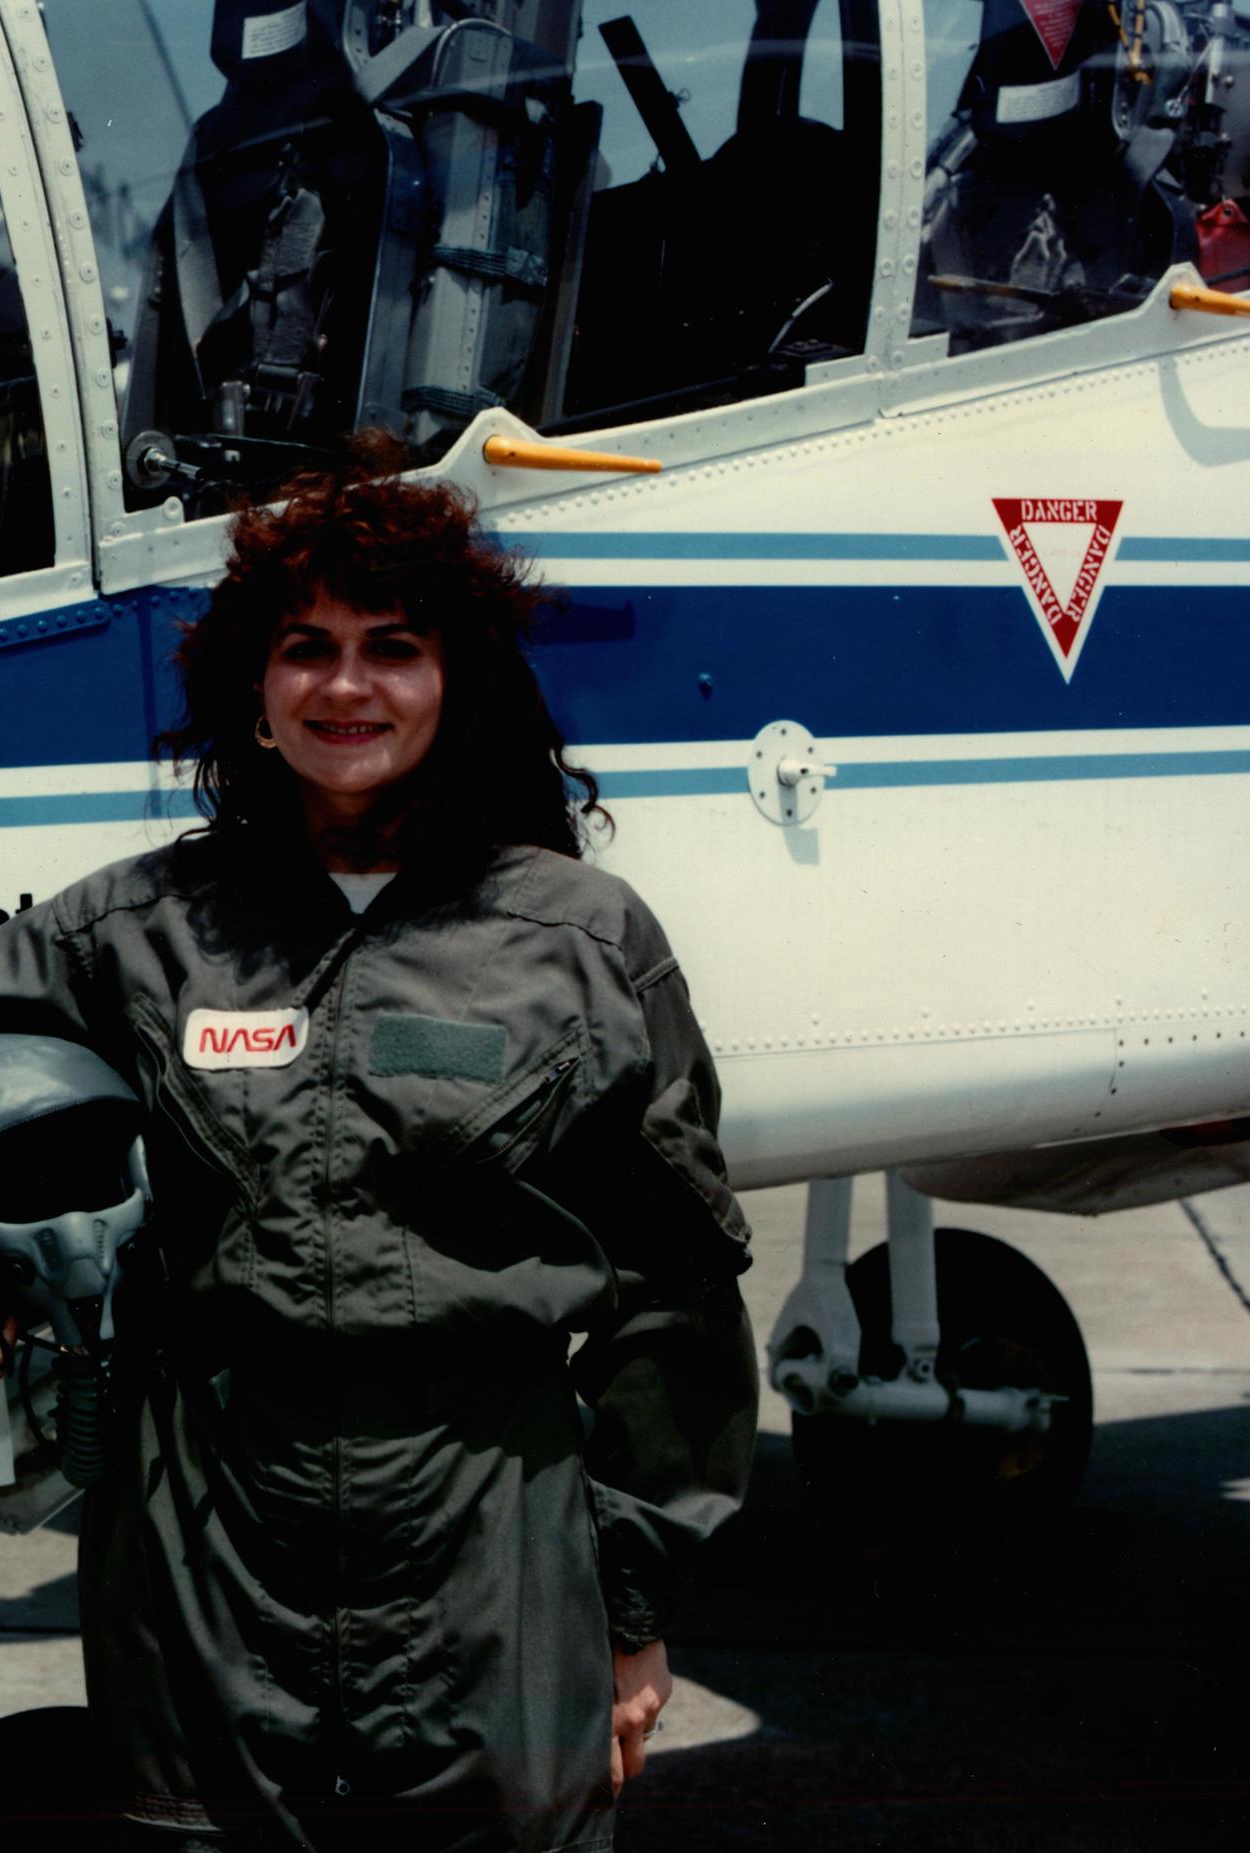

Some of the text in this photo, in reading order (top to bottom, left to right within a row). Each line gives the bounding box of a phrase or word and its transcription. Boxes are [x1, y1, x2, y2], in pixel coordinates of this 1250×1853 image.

[1021, 501, 1098, 521] DANGER
[1009, 524, 1063, 625] DANGER
[1065, 525, 1111, 622] DANGER
[199, 1024, 297, 1053] NASA
